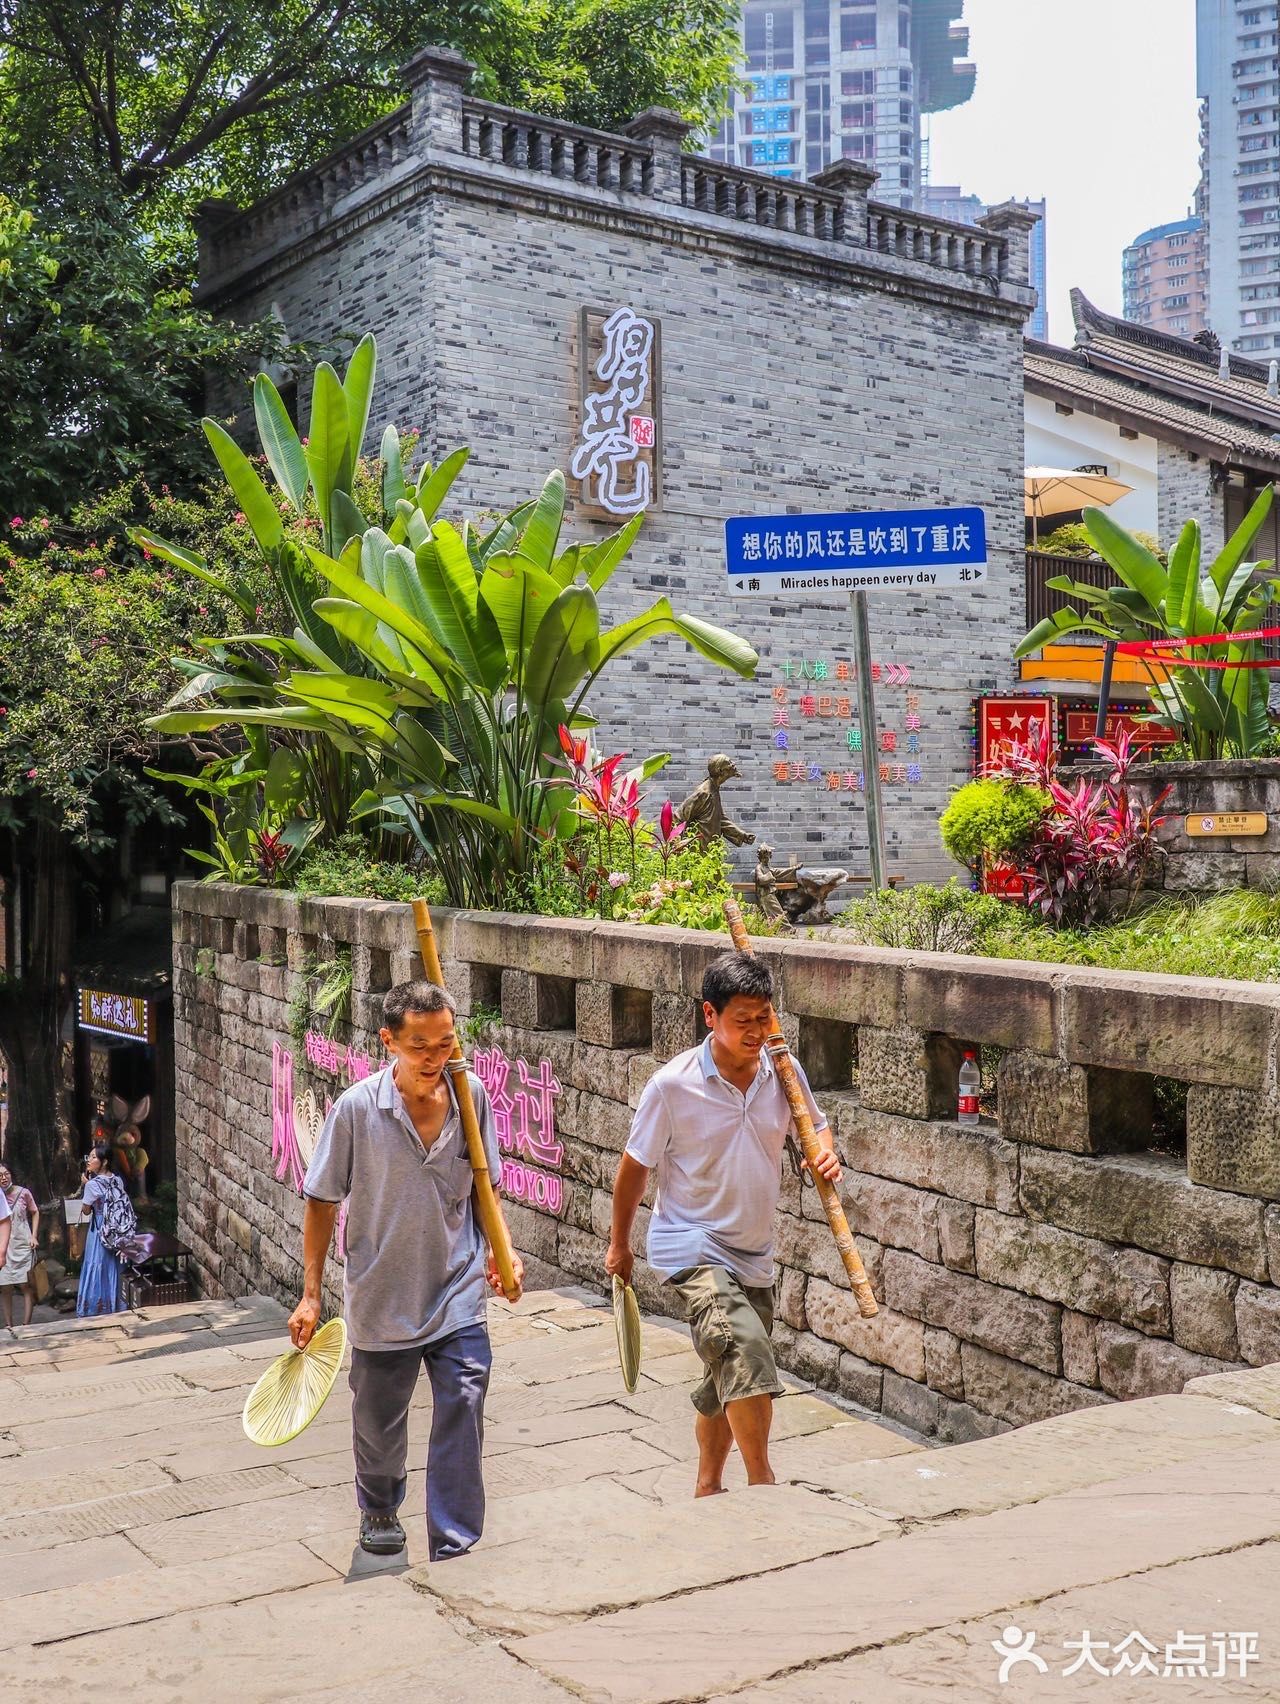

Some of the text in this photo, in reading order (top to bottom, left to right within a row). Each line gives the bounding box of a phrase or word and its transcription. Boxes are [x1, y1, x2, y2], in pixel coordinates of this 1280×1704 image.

[742, 523, 971, 560] 想你的风还是吹到了重庆
[748, 578, 760, 591] 南
[781, 571, 937, 589] Miracles happeen every day
[959, 568, 971, 581] 北
[780, 660, 828, 681] 十八梯
[772, 684, 789, 750] 吃美食
[800, 694, 851, 718] 嘿巴适
[906, 694, 920, 753] 拍美景
[773, 761, 822, 782] 看美女
[474, 1045, 564, 1168] 路过
